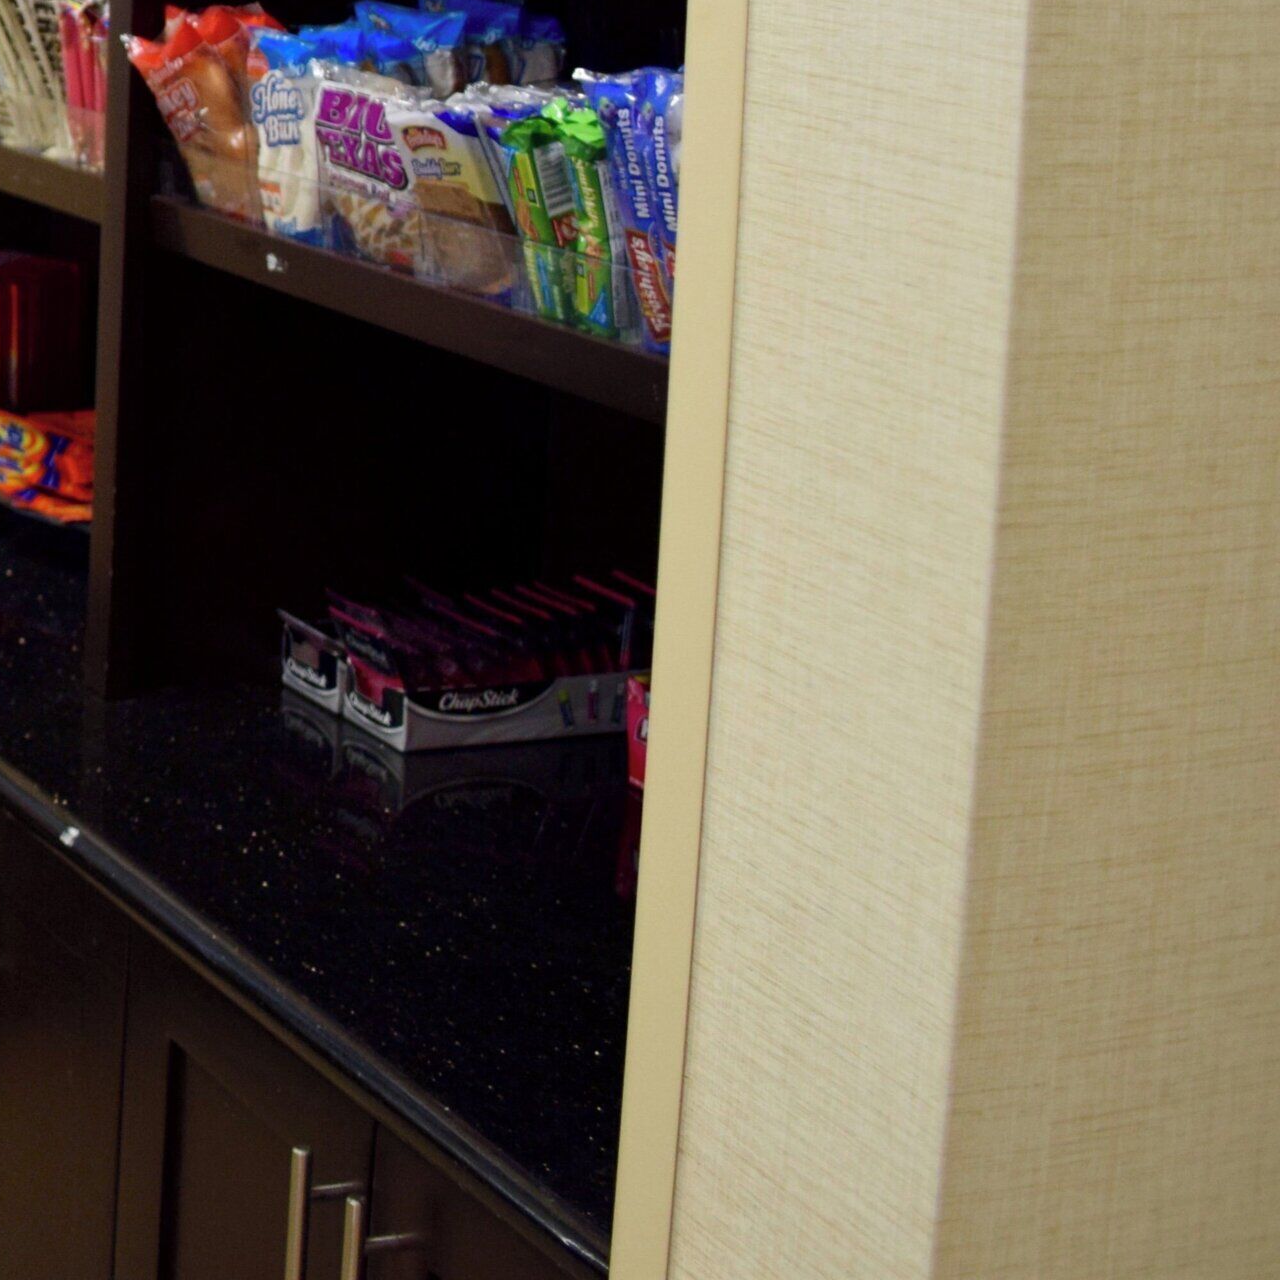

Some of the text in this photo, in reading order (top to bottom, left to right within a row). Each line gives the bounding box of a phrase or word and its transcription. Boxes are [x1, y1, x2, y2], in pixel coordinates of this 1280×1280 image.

[617, 107, 641, 176] Donuts
[630, 180, 651, 218] Mini
[652, 115, 677, 232] Mini Donuts
[439, 687, 519, 714] ChapStick
